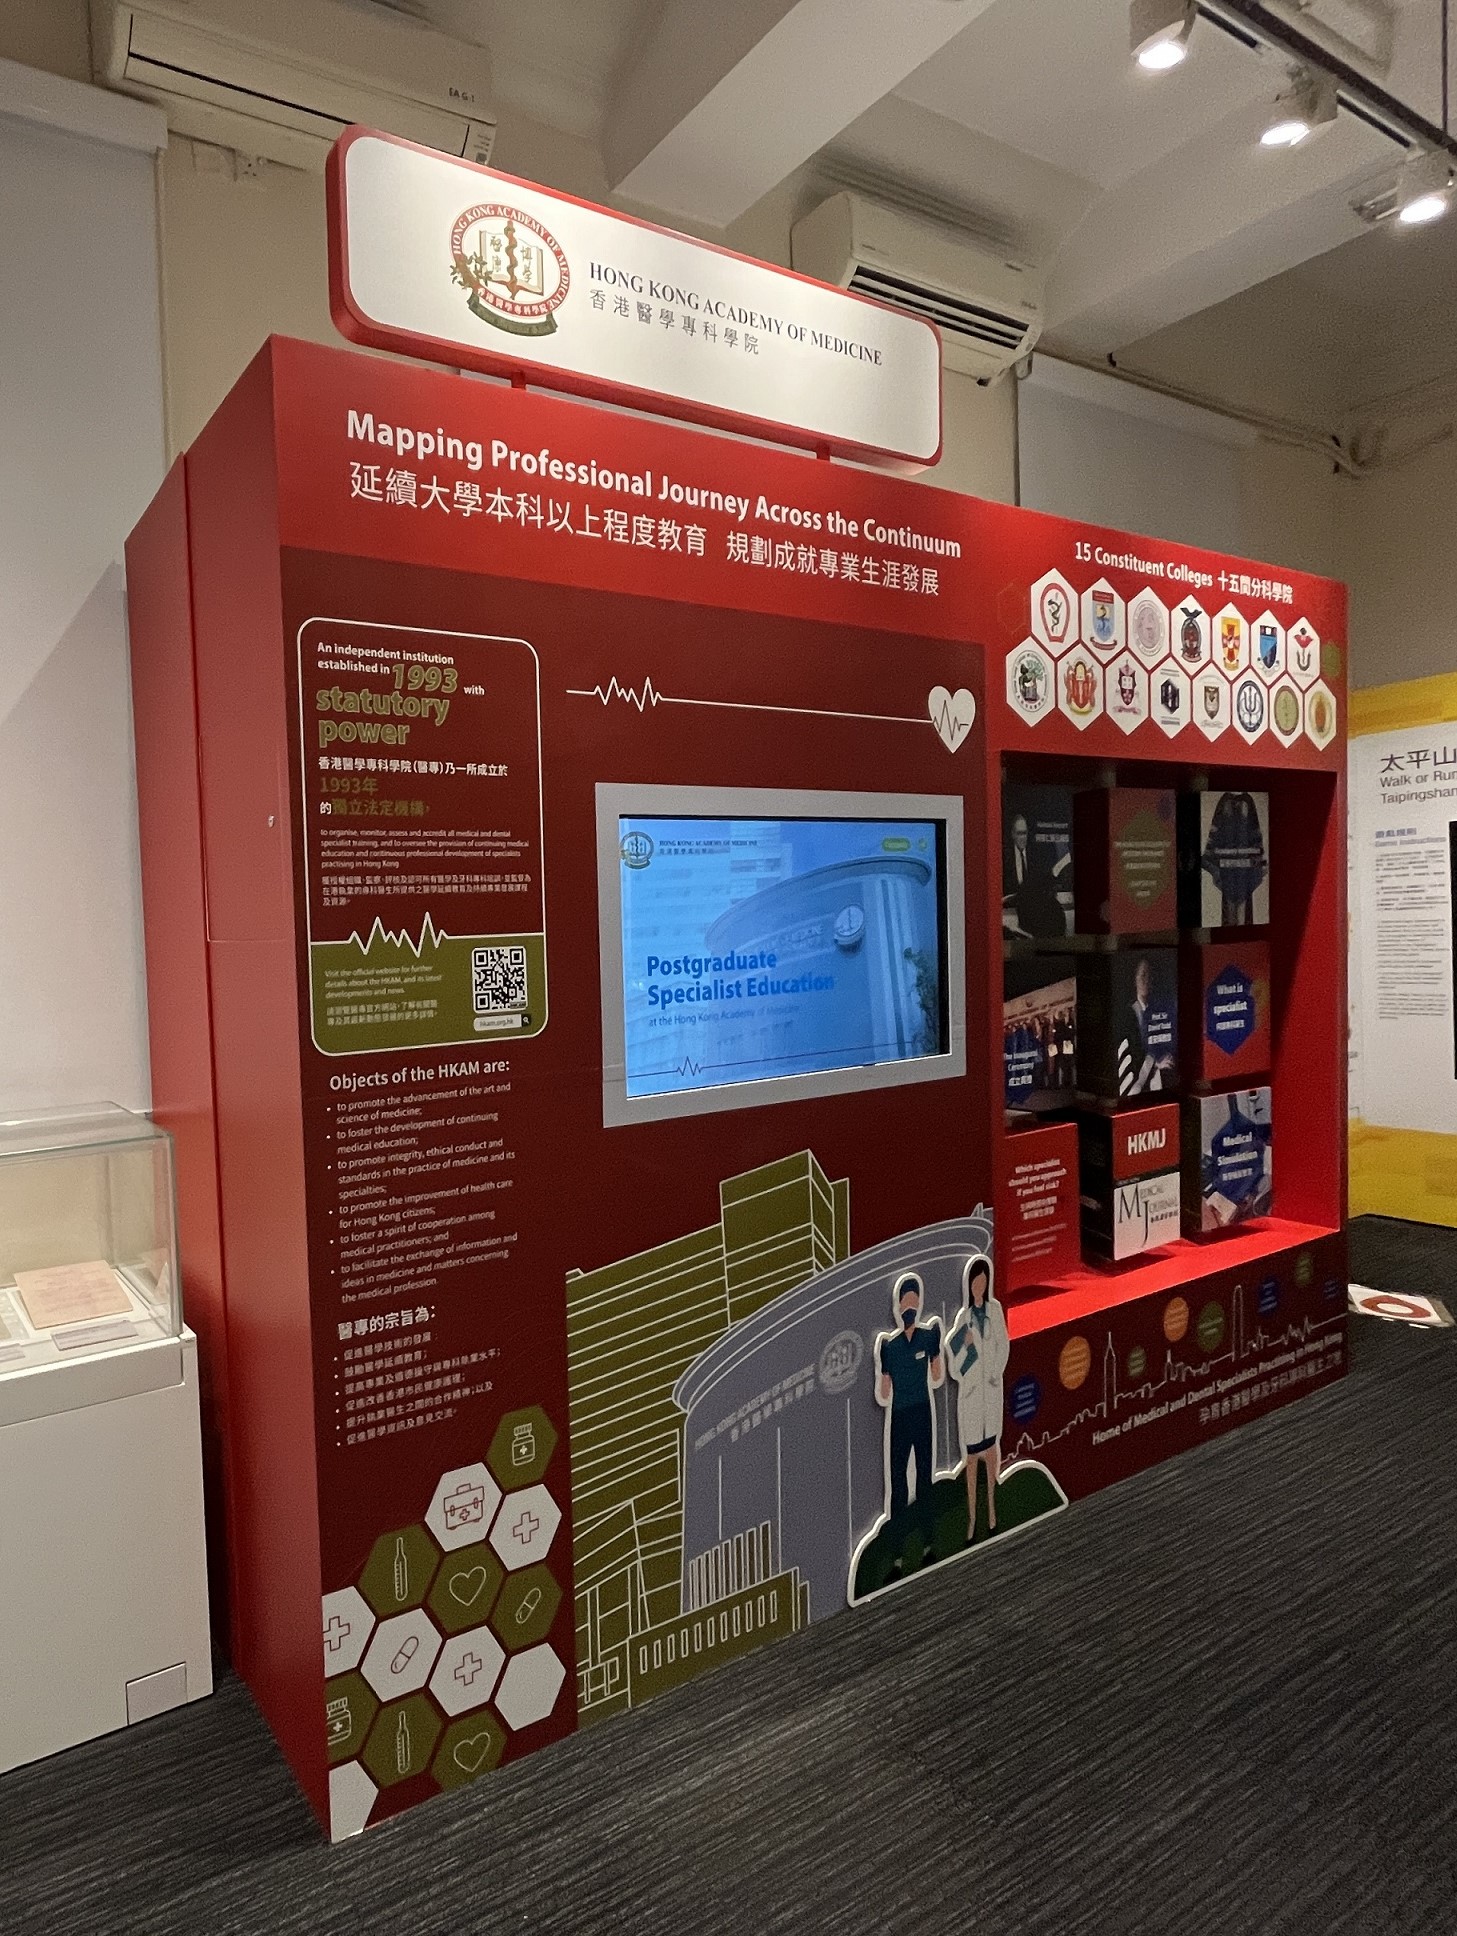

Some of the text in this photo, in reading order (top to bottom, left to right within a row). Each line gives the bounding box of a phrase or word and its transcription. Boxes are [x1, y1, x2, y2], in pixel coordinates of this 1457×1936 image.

[465, 205, 495, 223] KONG
[496, 206, 549, 238] ACADEMY
[589, 262, 883, 366] HONG KONG ACADEMY OF MEDICINE
[589, 289, 760, 355] 香港醫學專科學院
[347, 409, 961, 558] Mapping Professional Journey Across the Continuum
[349, 461, 940, 596] 延續大學本科以上程度教育 規劃成就專業生涯發展
[1075, 541, 1213, 588] 15 Constituent Colleges
[1217, 570, 1293, 605] 十五間分科學院
[317, 641, 453, 664] An independent institution
[317, 659, 485, 696] established in 1993 with
[316, 686, 450, 726] statutory
[318, 719, 410, 748] power
[320, 777, 379, 795] 1993年
[1380, 774, 1411, 788] Walk
[1415, 774, 1428, 784] or
[647, 950, 778, 979] Postgraduate
[648, 973, 835, 1010] Specialist Education
[649, 1018, 656, 1026] at
[658, 1015, 672, 1025] the
[674, 1015, 696, 1025] Hong
[698, 1013, 719, 1022] Kong
[330, 1060, 510, 1091] Objects of the HKAM are:
[336, 1082, 510, 1112] to promote the advancement of the art and
[336, 1107, 422, 1124] science of medicine;
[336, 1112, 498, 1139] to foster the development of continuing
[337, 1137, 418, 1154] medical education;
[337, 1138, 503, 1169] to promote integrity, ethical conduct and
[1127, 1128, 1166, 1156] HKMJ
[337, 1169, 381, 1184] standards
[382, 1169, 391, 1177] in
[392, 1166, 406, 1176] the
[408, 1162, 441, 1175] practice
[442, 1158, 451, 1168] of
[452, 1155, 488, 1167] medicine
[489, 1150, 504, 1161] and
[339, 1179, 513, 1214] to promote the improvement of health care
[339, 1206, 435, 1228] for Hong Kong citizens;
[339, 1210, 495, 1243] to foster a spirit of cooperation among
[340, 1230, 449, 1258] medical practitioners; and
[340, 1231, 517, 1273] to facilitate the exchange of information and
[341, 1249, 509, 1288] ideas in medicine and matters concerning
[341, 1293, 356, 1303] the
[357, 1284, 391, 1299] medical
[1093, 1425, 1121, 1445] Home
[1122, 1416, 1133, 1432] of
[1133, 1401, 1169, 1428] Medical
[1170, 1394, 1186, 1412] and
[1188, 1381, 1215, 1405] Dental
